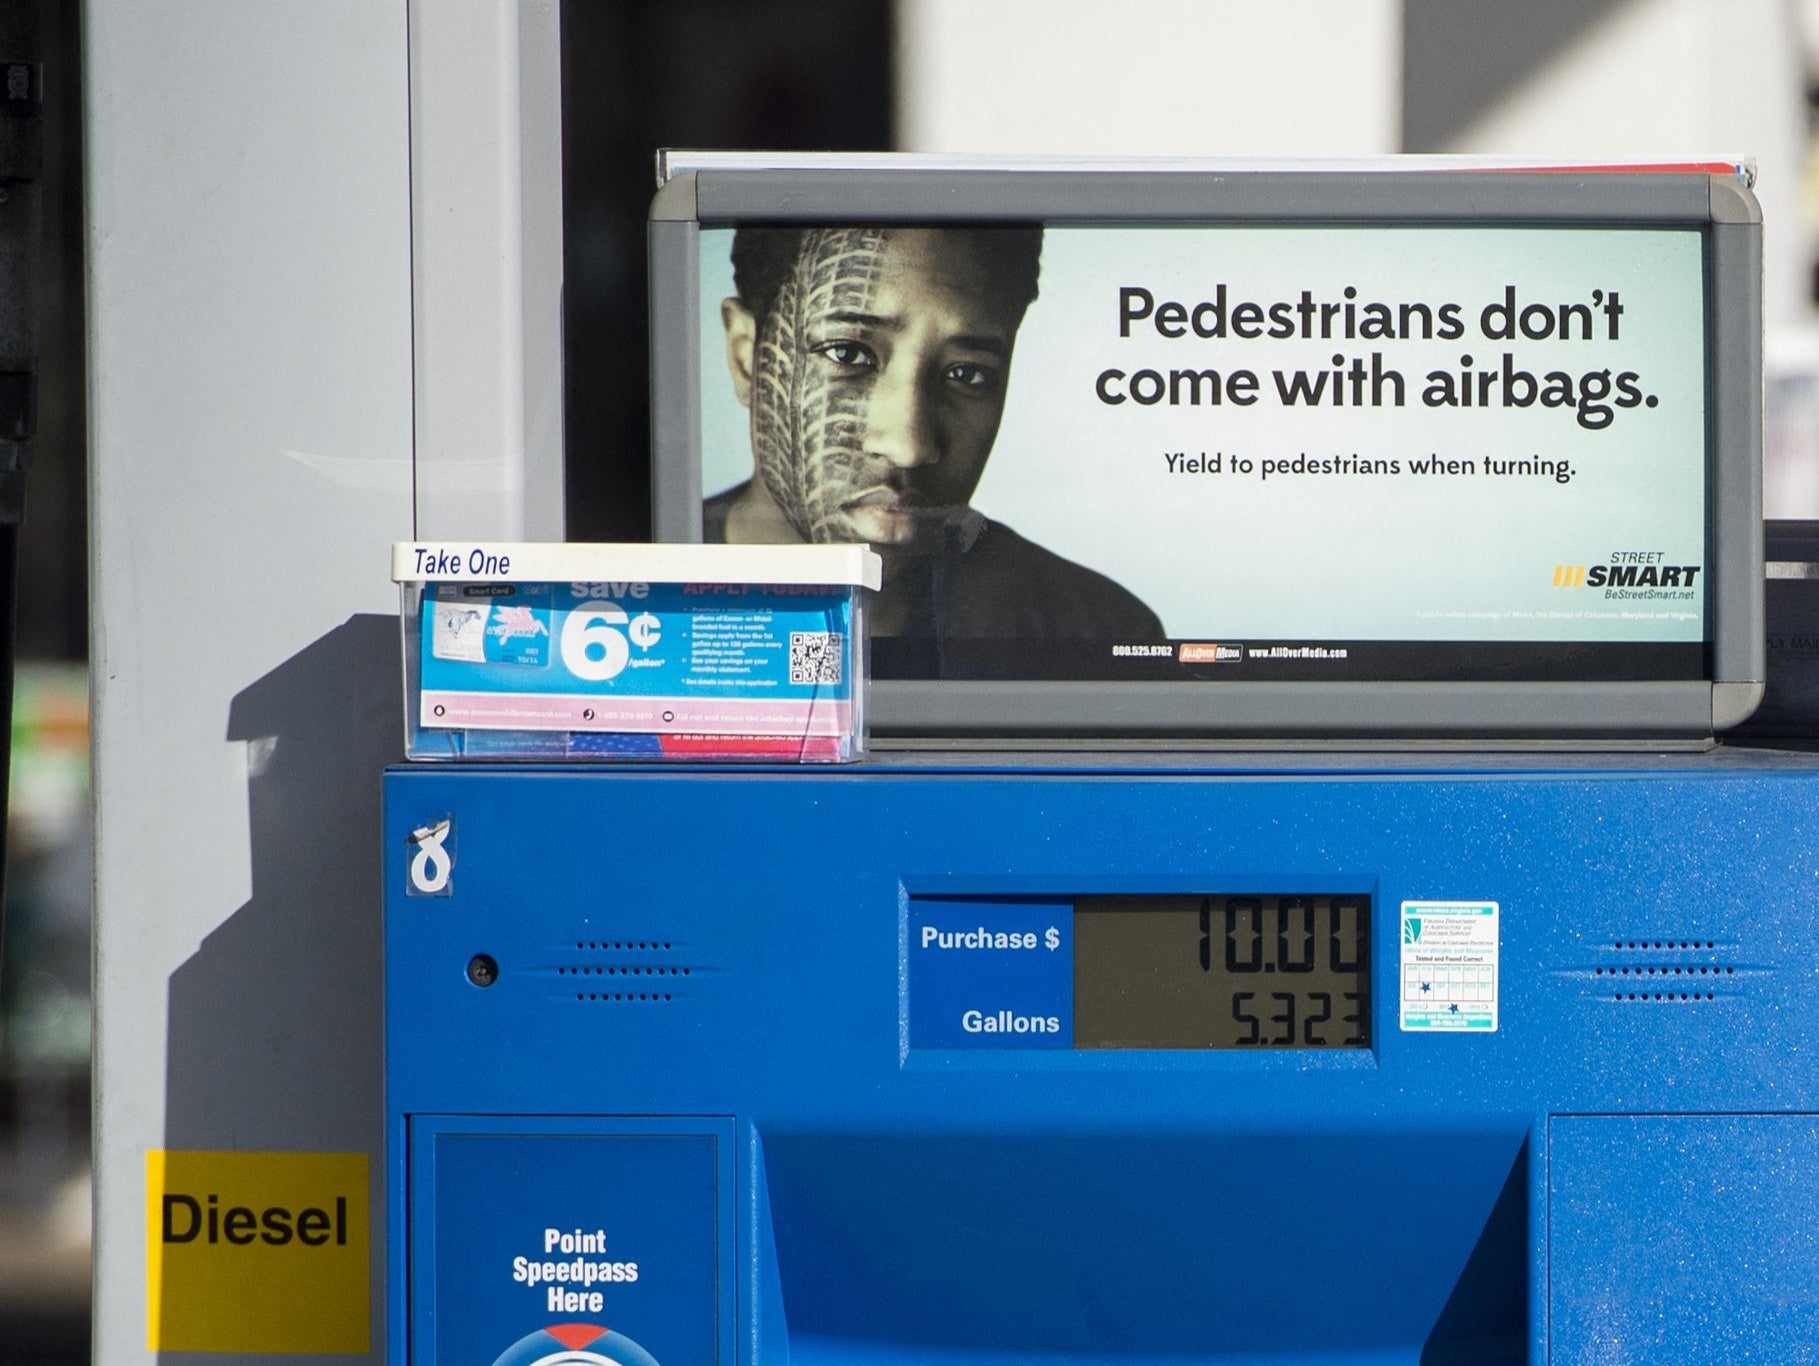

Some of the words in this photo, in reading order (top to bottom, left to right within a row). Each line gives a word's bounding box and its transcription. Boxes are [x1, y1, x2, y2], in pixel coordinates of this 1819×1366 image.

[1119, 284, 1465, 339] Pedestrians
[1480, 285, 1624, 340] don't
[1096, 368, 1260, 406] come
[1273, 352, 1405, 407] with
[1422, 352, 1659, 430] airbags.
[1165, 453, 1221, 474] Yield
[1230, 454, 1253, 474] to
[1262, 453, 1400, 480] pedestrians
[1408, 454, 1476, 475] when
[1484, 454, 1576, 484] turning.
[414, 548, 461, 575] Take
[468, 548, 510, 575] One
[1611, 552, 1664, 563] STREET
[1587, 566, 1701, 587] SMART
[571, 582, 650, 599] save
[1605, 589, 1694, 600] BeStreetSmart.net
[921, 926, 1038, 953] Purchase
[1044, 925, 1061, 953] $
[962, 1009, 1060, 1034] Gallons
[1232, 992, 1368, 1045] 5.323
[162, 1194, 347, 1246] Diesel
[545, 1228, 606, 1254] Point
[513, 1257, 638, 1286] Speedpass
[548, 1287, 603, 1313] Here
